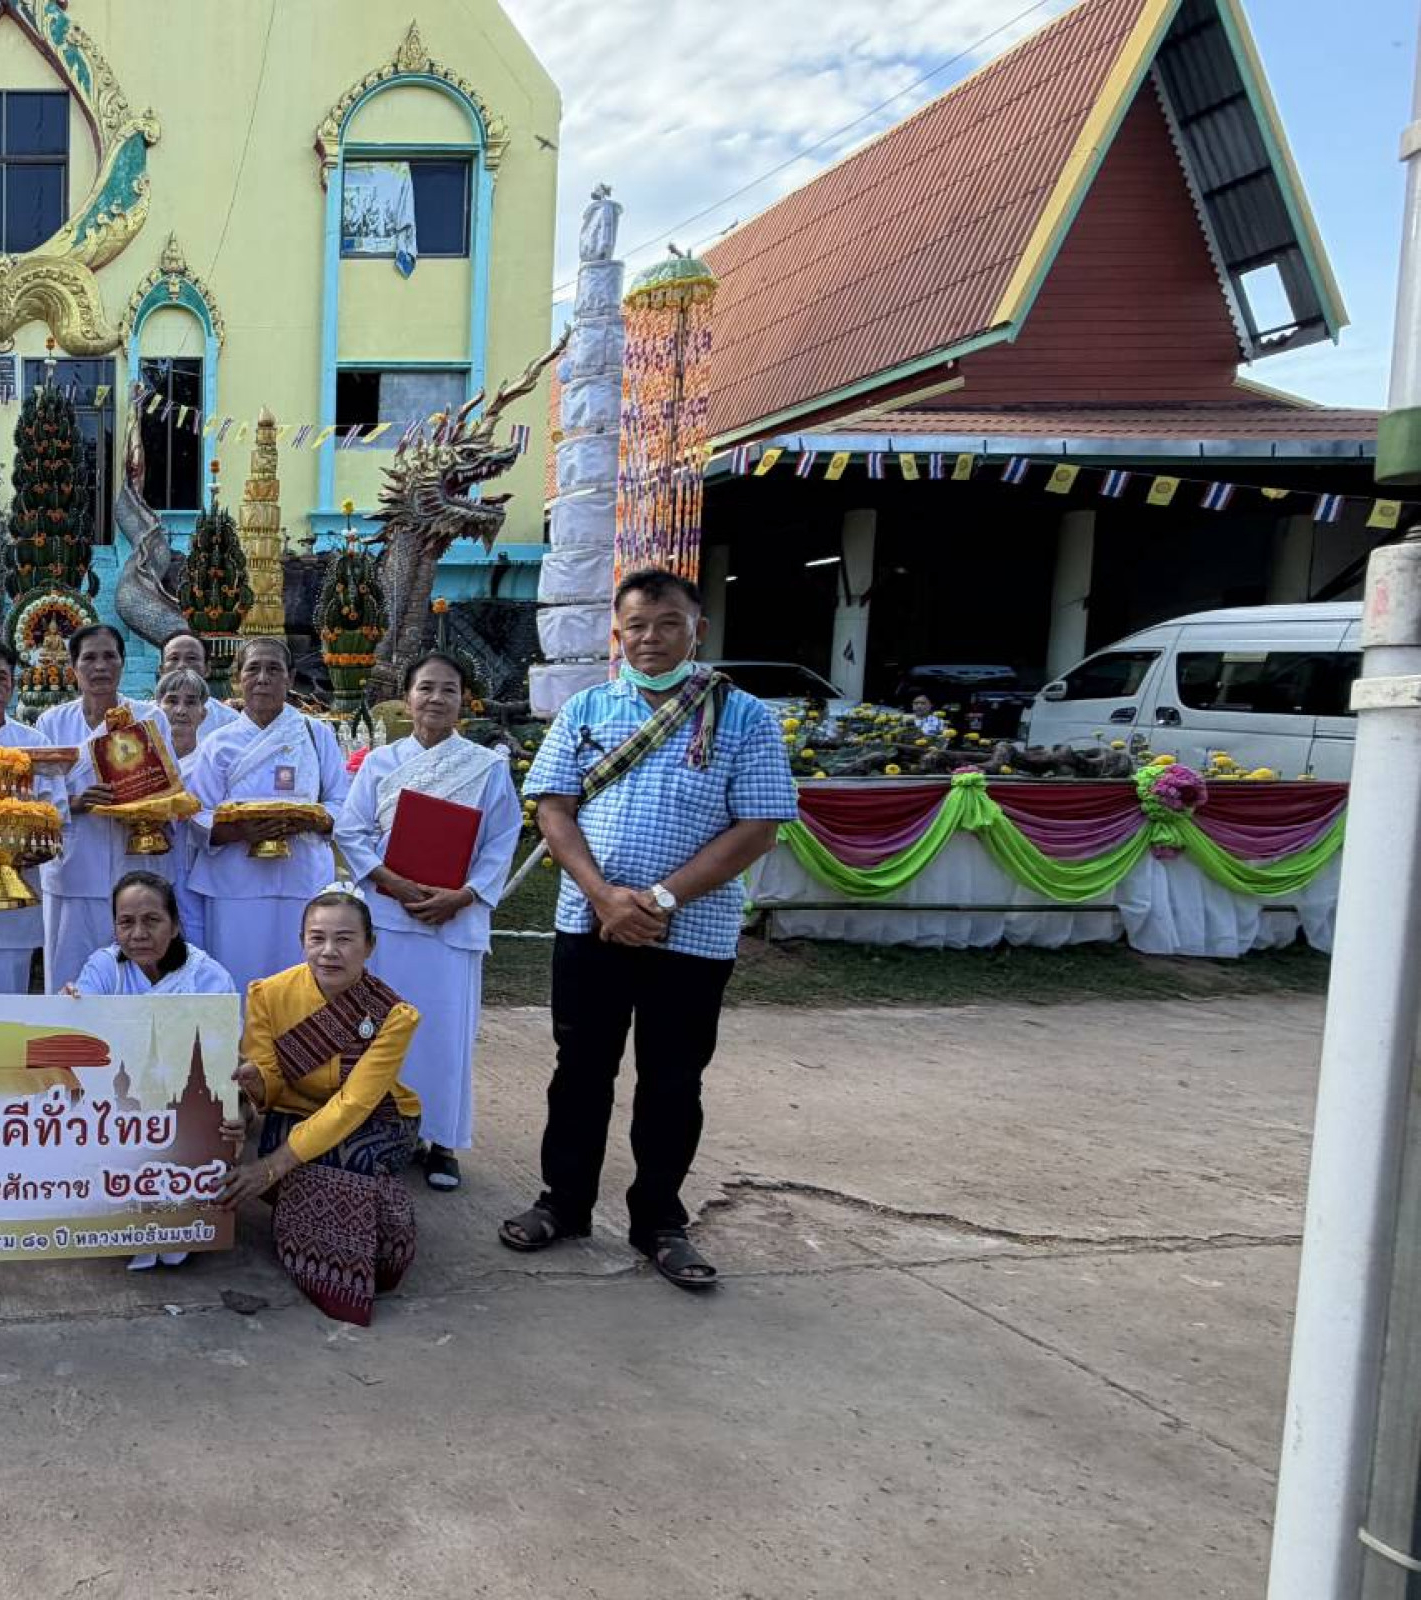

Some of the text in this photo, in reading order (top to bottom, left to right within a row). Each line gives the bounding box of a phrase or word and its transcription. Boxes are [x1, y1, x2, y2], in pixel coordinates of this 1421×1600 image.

[103, 1166, 223, 1197] ๒๕๖๘
[55, 1226, 68, 1246] ปี
[75, 1221, 215, 1247] หลวงพ่อธัมมชโย
